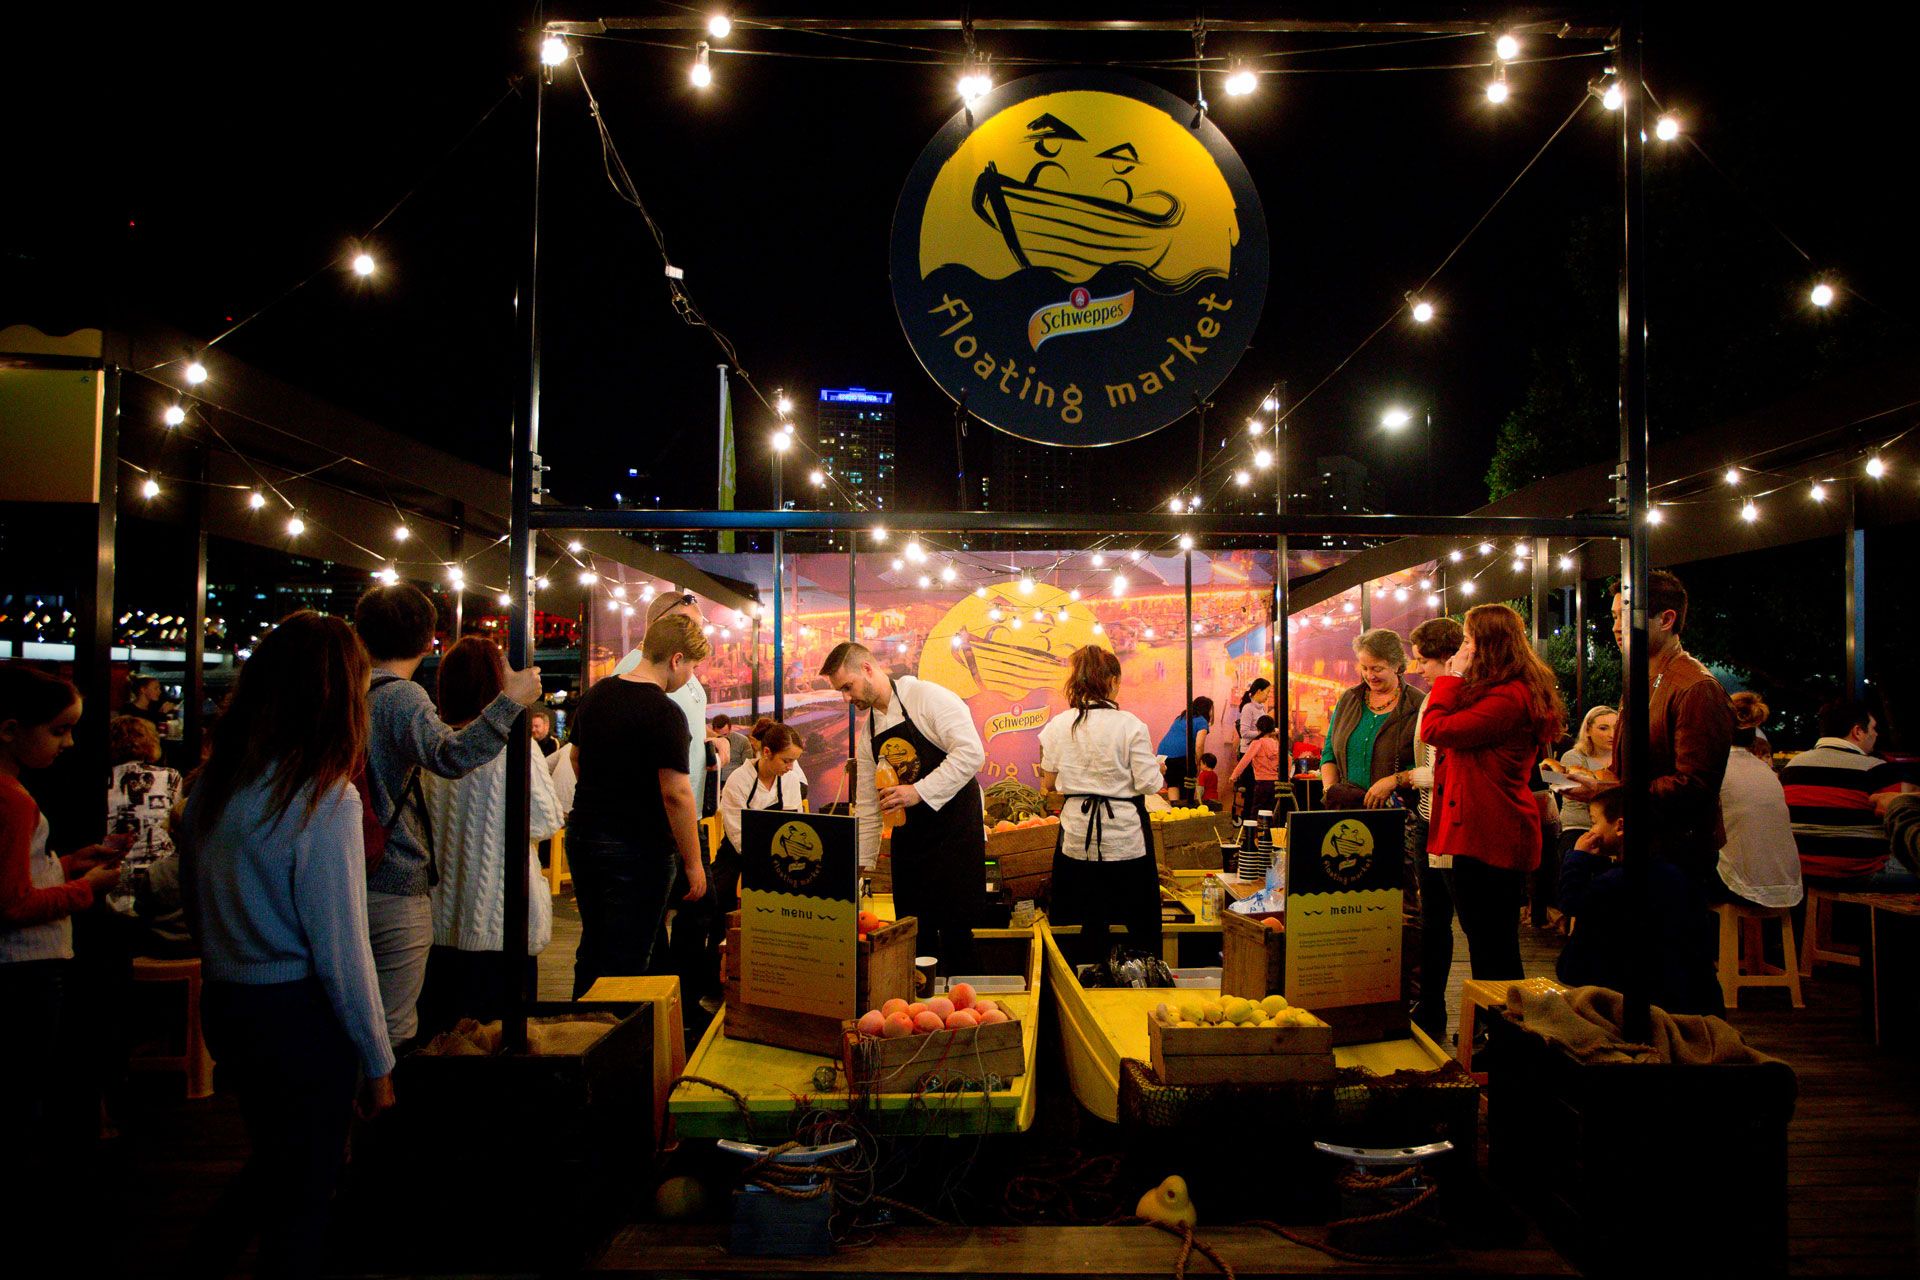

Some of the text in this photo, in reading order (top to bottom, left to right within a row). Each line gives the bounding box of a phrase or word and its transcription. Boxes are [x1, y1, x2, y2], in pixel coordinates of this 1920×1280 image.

[1039, 303, 1124, 335] Schweppes
[927, 291, 1233, 424] floating market
[991, 713, 1044, 733] Schweppes
[781, 907, 813, 920] menu
[1330, 904, 1362, 915] menu
